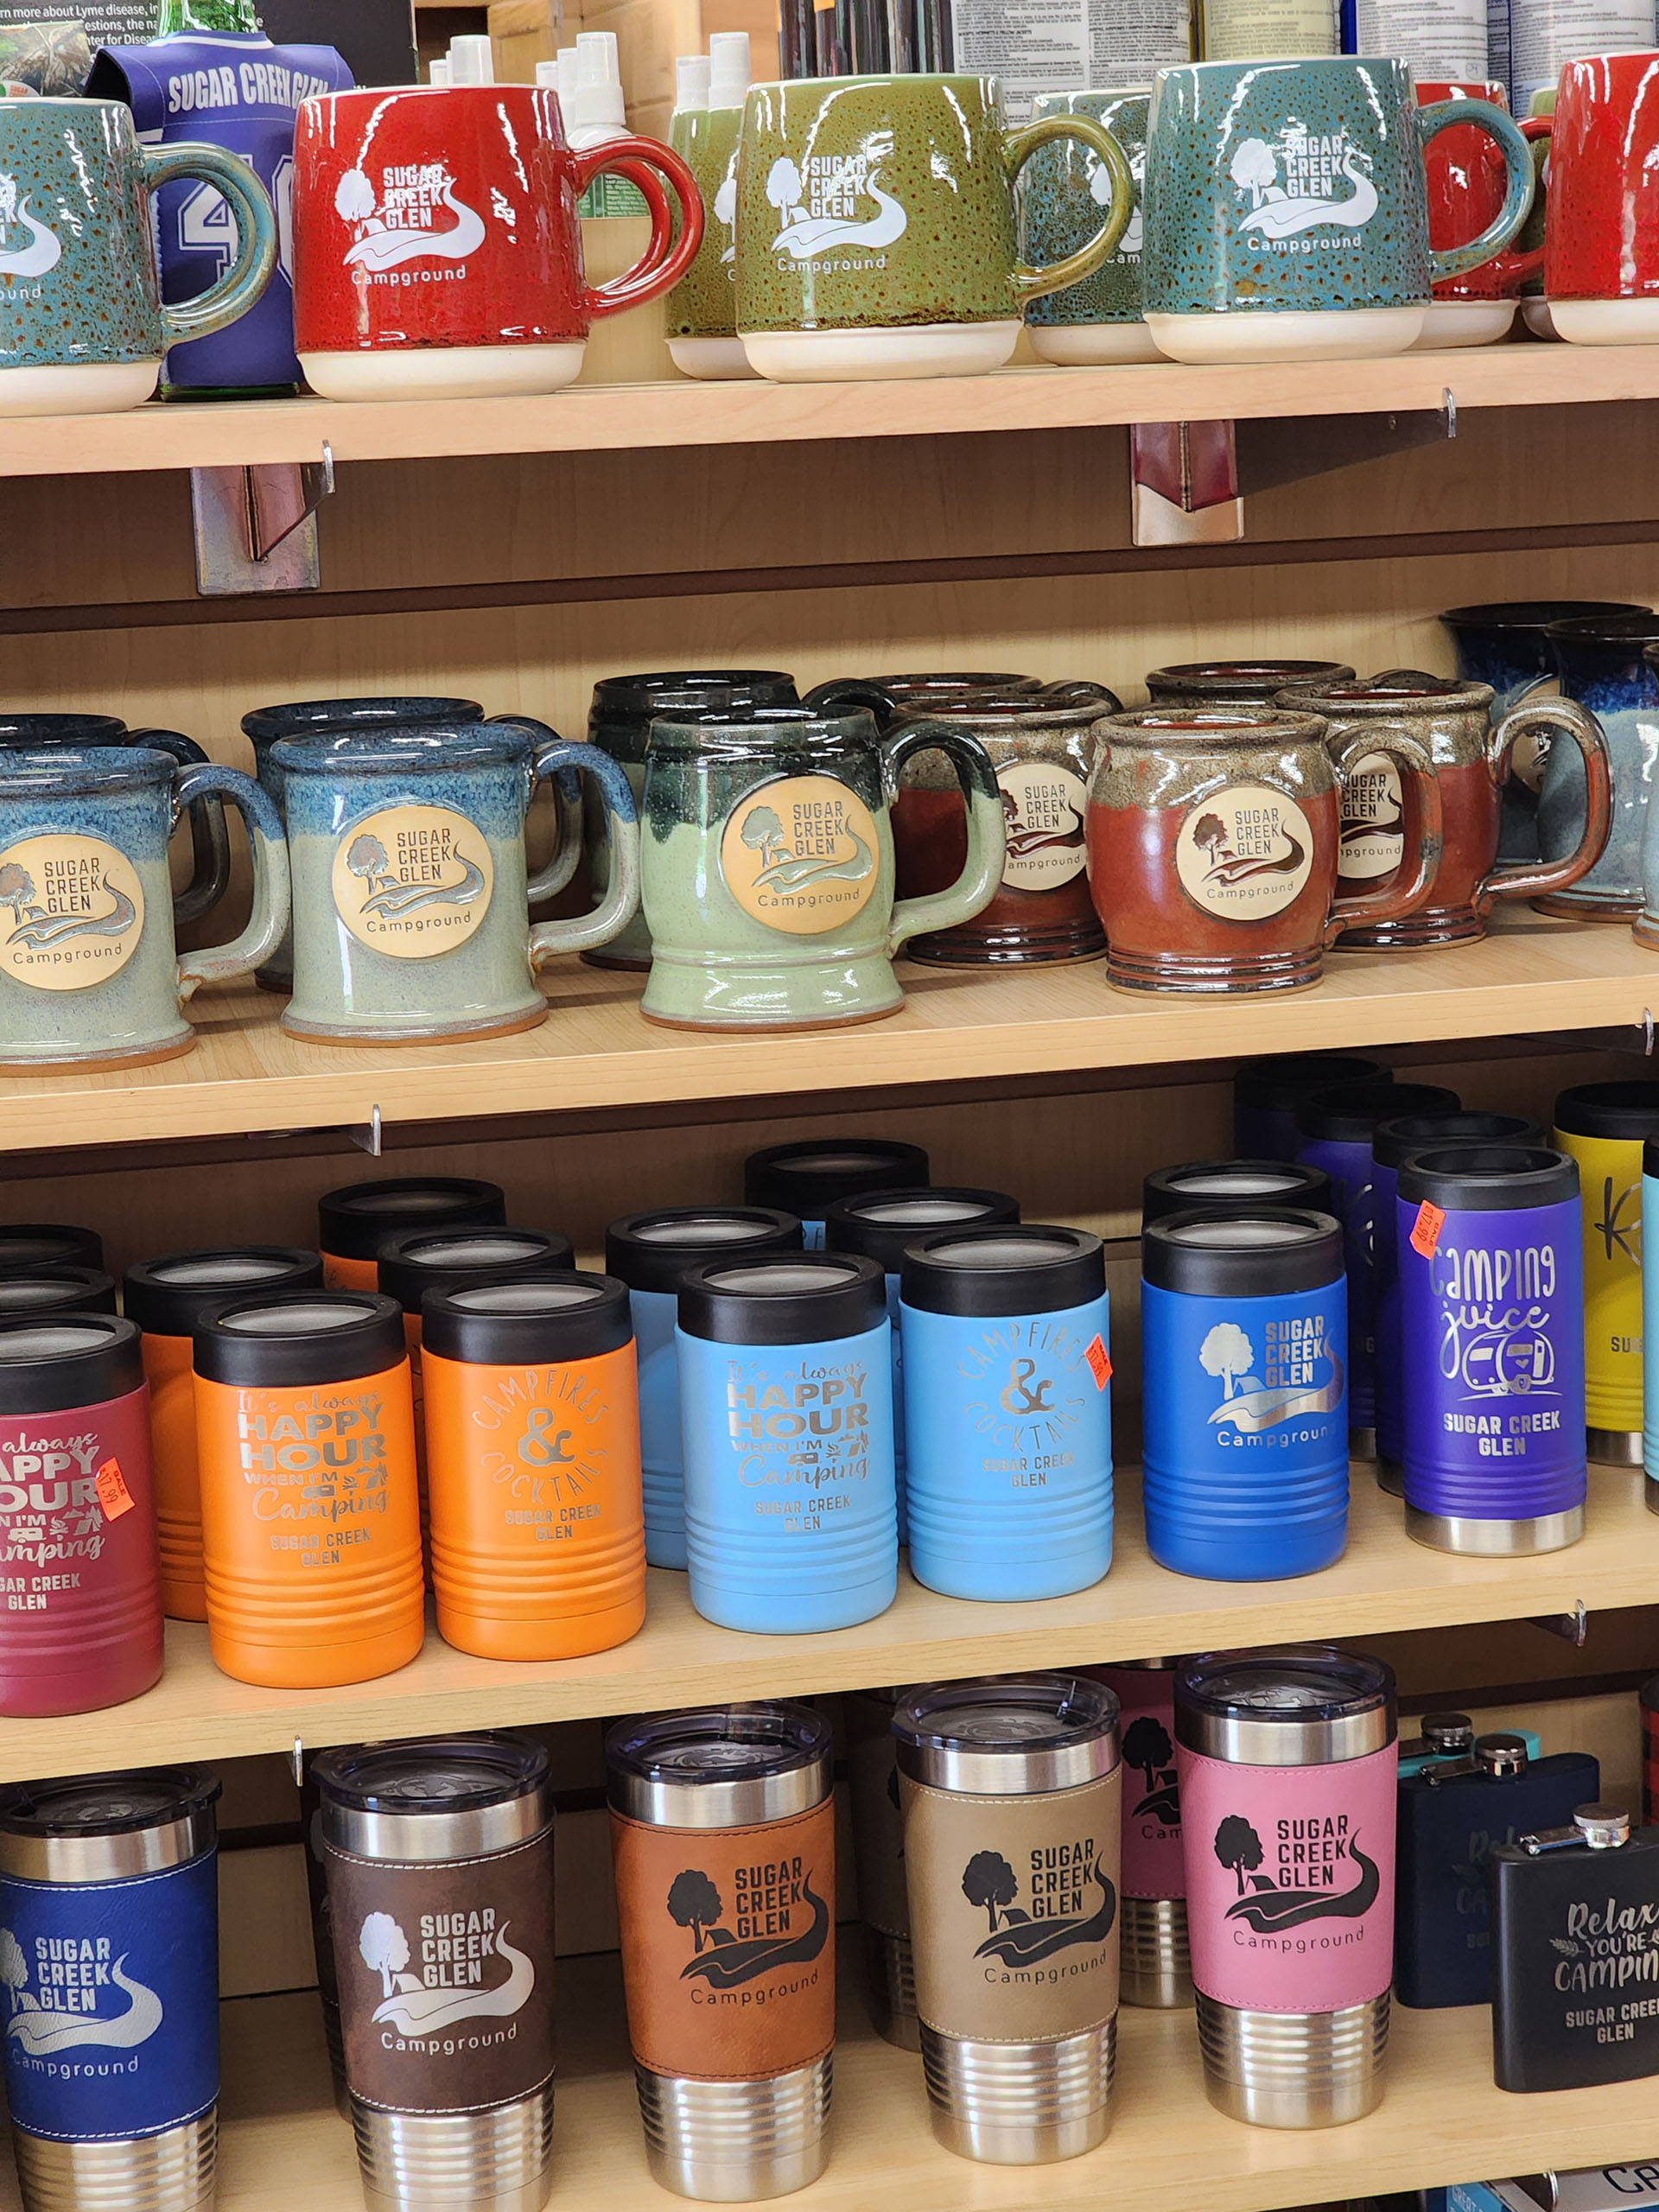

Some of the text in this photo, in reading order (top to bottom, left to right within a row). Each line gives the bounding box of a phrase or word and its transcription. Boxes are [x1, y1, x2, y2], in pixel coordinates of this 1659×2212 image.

[13, 8, 41, 18] more
[42, 5, 74, 17] about
[76, 4, 104, 19] Lyme
[105, 3, 148, 17] disease,
[126, 18, 145, 30] the
[106, 34, 122, 45] for
[168, 66, 238, 113] SUGAR
[238, 62, 292, 108] CREEK
[383, 163, 443, 188] SUGAR
[810, 154, 868, 176] SUGAR
[1286, 156, 1343, 178] CREEK
[384, 185, 443, 209] CREEK
[810, 175, 868, 197] CREEK
[1287, 176, 1332, 198] GLEN
[385, 207, 433, 229] GLEN
[810, 197, 855, 218] GLEN
[1247, 232, 1362, 253] Campground
[350, 264, 467, 287] Campground
[777, 254, 887, 275] Campground
[1025, 784, 1066, 799] SUGAR
[1344, 774, 1387, 788] UGAR
[792, 800, 843, 820] SUGAR
[1027, 798, 1067, 815] CREEK
[1235, 807, 1280, 825] SUGAR
[1343, 804, 1376, 817] GLEN
[794, 818, 844, 838] CREEK
[1027, 814, 1059, 829] GLEN
[1236, 823, 1280, 841] CREEK
[397, 828, 452, 848] SUGAR
[794, 838, 836, 857] GLEN
[1237, 840, 1272, 856] GLEN
[397, 846, 452, 866] CREEK
[1007, 855, 1081, 870] ampground
[44, 857, 101, 878] SUGAR
[399, 864, 442, 883] GLEN
[46, 875, 102, 895] CREEK
[1206, 880, 1294, 899] Campground
[48, 894, 92, 914] GLEN
[757, 888, 861, 908] Campground
[366, 911, 472, 933] Campground
[13, 943, 123, 965] Campground
[1265, 1315, 1325, 1343] SUGAR
[1440, 1300, 1550, 1379] juice
[957, 1321, 1085, 1380] CAMPFIRES
[1265, 1338, 1324, 1364] CREEK
[784, 1361, 864, 1381] always
[1265, 1361, 1313, 1388] GLEN
[727, 1372, 868, 1410] HAPPY
[1001, 1358, 1055, 1415] &
[294, 1390, 379, 1412] always
[472, 1369, 609, 1430] CAMPFIRES
[237, 1403, 384, 1440] HAPPY
[728, 1402, 869, 1439] HOUR
[963, 1397, 1086, 1452] COCKTAILS
[1443, 1410, 1560, 1435] SUGAR CREEK
[2, 1432, 99, 1454] always
[518, 1408, 575, 1467] &
[731, 1439, 823, 1452] WHEN I'M
[1217, 1426, 1335, 1448] Campgroun
[1478, 1437, 1526, 1457] GLEN
[239, 1433, 387, 1471] HOUR
[982, 1452, 1075, 1472] SUGAR CREEK
[244, 1471, 338, 1485] WHEN I'M
[480, 1446, 608, 1504] COCKTAILS
[739, 1454, 870, 1489] Camping
[1011, 1472, 1047, 1488] GLEN
[252, 1487, 388, 1523] Camping
[505, 1503, 601, 1525] SUGAR CREEK
[754, 1495, 851, 1515] SUGAR CREEK
[16, 1514, 48, 1527] I'M
[785, 1515, 821, 1533] GLEN
[270, 1528, 372, 1550] SUGAR CREEK
[536, 1525, 573, 1541] GLEN
[0, 1535, 105, 1568] mping
[302, 1550, 340, 1567] GLEN
[31, 1573, 81, 1592] CREEK
[8, 1593, 48, 1611] GLEN
[1276, 1815, 1349, 1840] SUGAR
[1030, 1838, 1094, 1871] SUGAR
[1278, 1838, 1347, 1864] CREEK
[734, 1856, 802, 1890] SUGAR
[1031, 1862, 1093, 1895] CREEK
[1279, 1865, 1334, 1888] GLEN
[736, 1880, 802, 1915] CREEK
[1032, 1890, 1082, 1919] GLEN
[420, 1908, 496, 1938] SUGAR
[737, 1909, 791, 1939] GLEN
[1567, 1897, 1659, 1941] Relax
[35, 1936, 111, 1961] SUGAR
[422, 1932, 495, 1963] CREEK
[1233, 1925, 1364, 1954] Campground
[1586, 1931, 1648, 1958] YOU'RE
[37, 1961, 111, 1986] CREEK
[423, 1960, 482, 1988] GLEN
[984, 1948, 1107, 1985] Campground
[690, 1968, 819, 2006] Campground
[40, 1986, 97, 2012] GLEN
[1566, 1998, 1659, 2028] SUGAR CREE
[380, 2022, 518, 2056] Campground
[1597, 2023, 1635, 2044] GLEN
[12, 2048, 139, 2080] Campground
